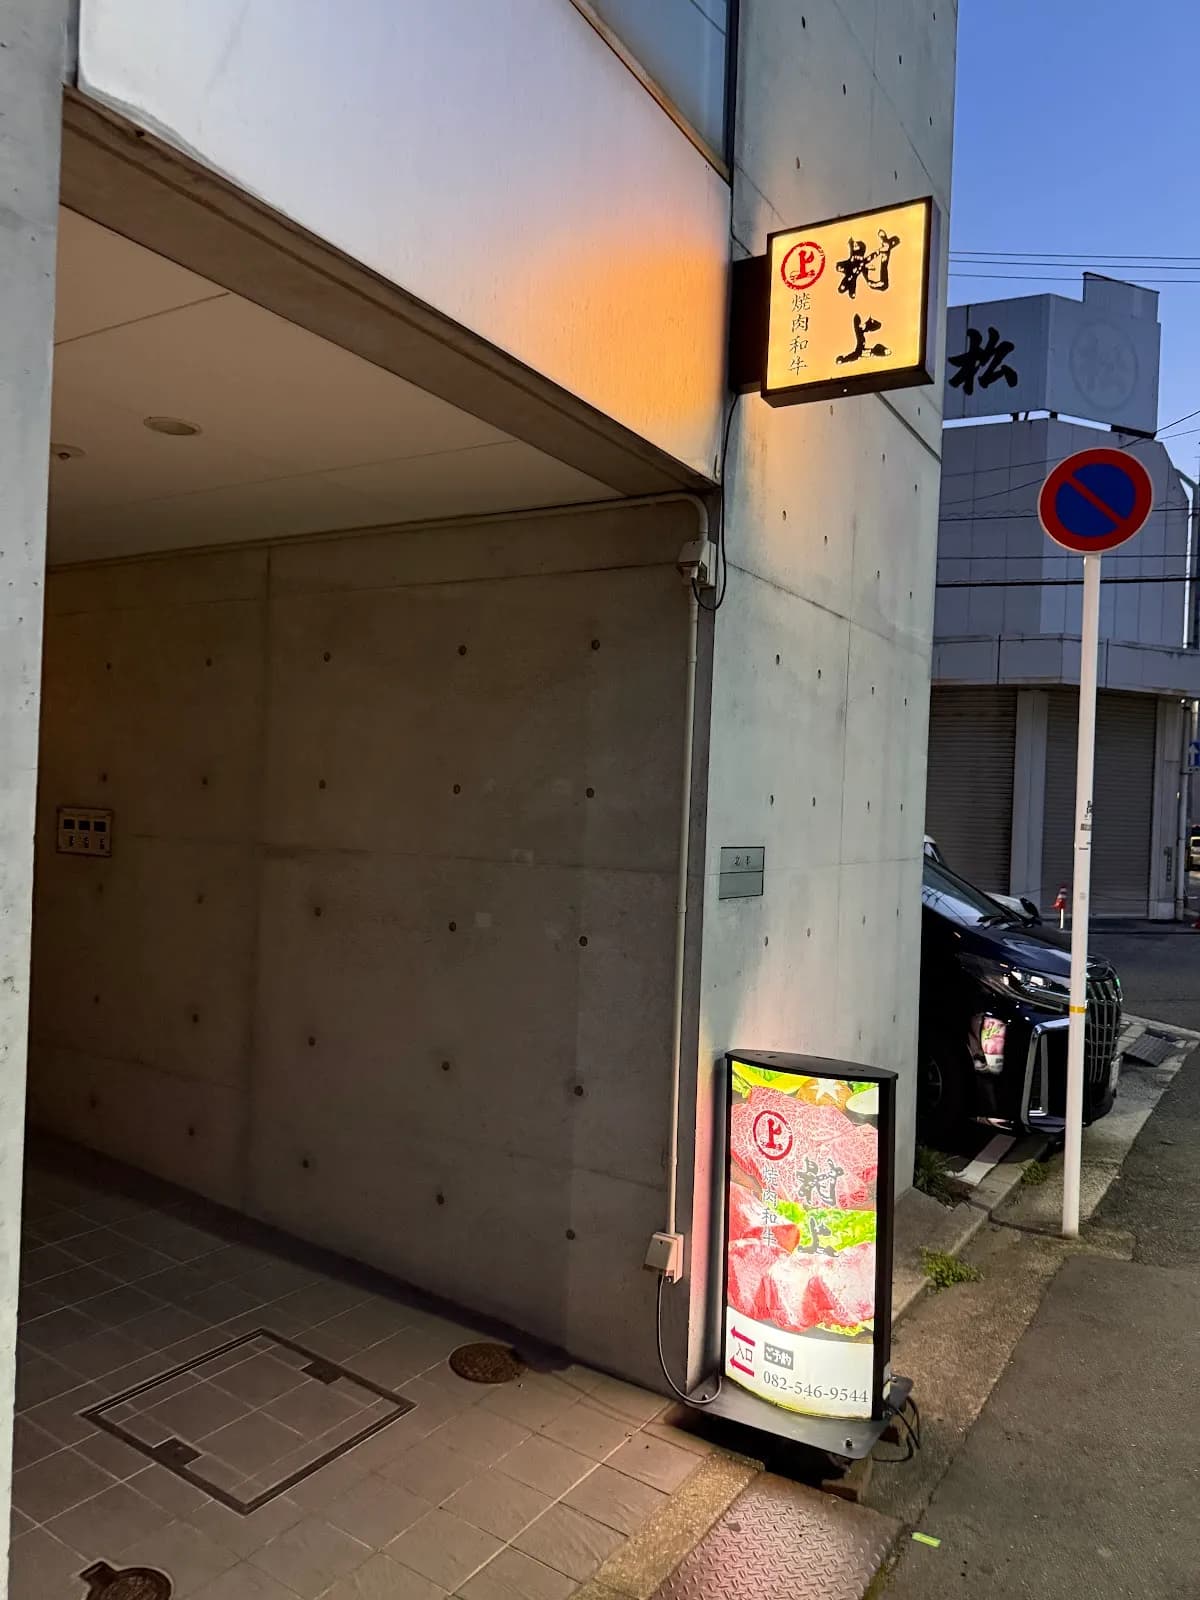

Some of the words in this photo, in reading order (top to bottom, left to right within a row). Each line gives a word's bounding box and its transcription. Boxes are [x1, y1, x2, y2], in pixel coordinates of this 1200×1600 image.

[788, 292, 812, 376] 焼肉和牛
[836, 229, 901, 365] 村上
[947, 326, 1018, 396] 松
[761, 1165, 780, 1247] 焼肉和牛
[796, 1157, 845, 1258] 村上
[735, 1341, 753, 1363] 入口
[763, 1370, 869, 1403] 082-546-9544
[765, 1345, 793, 1367] ご予約
